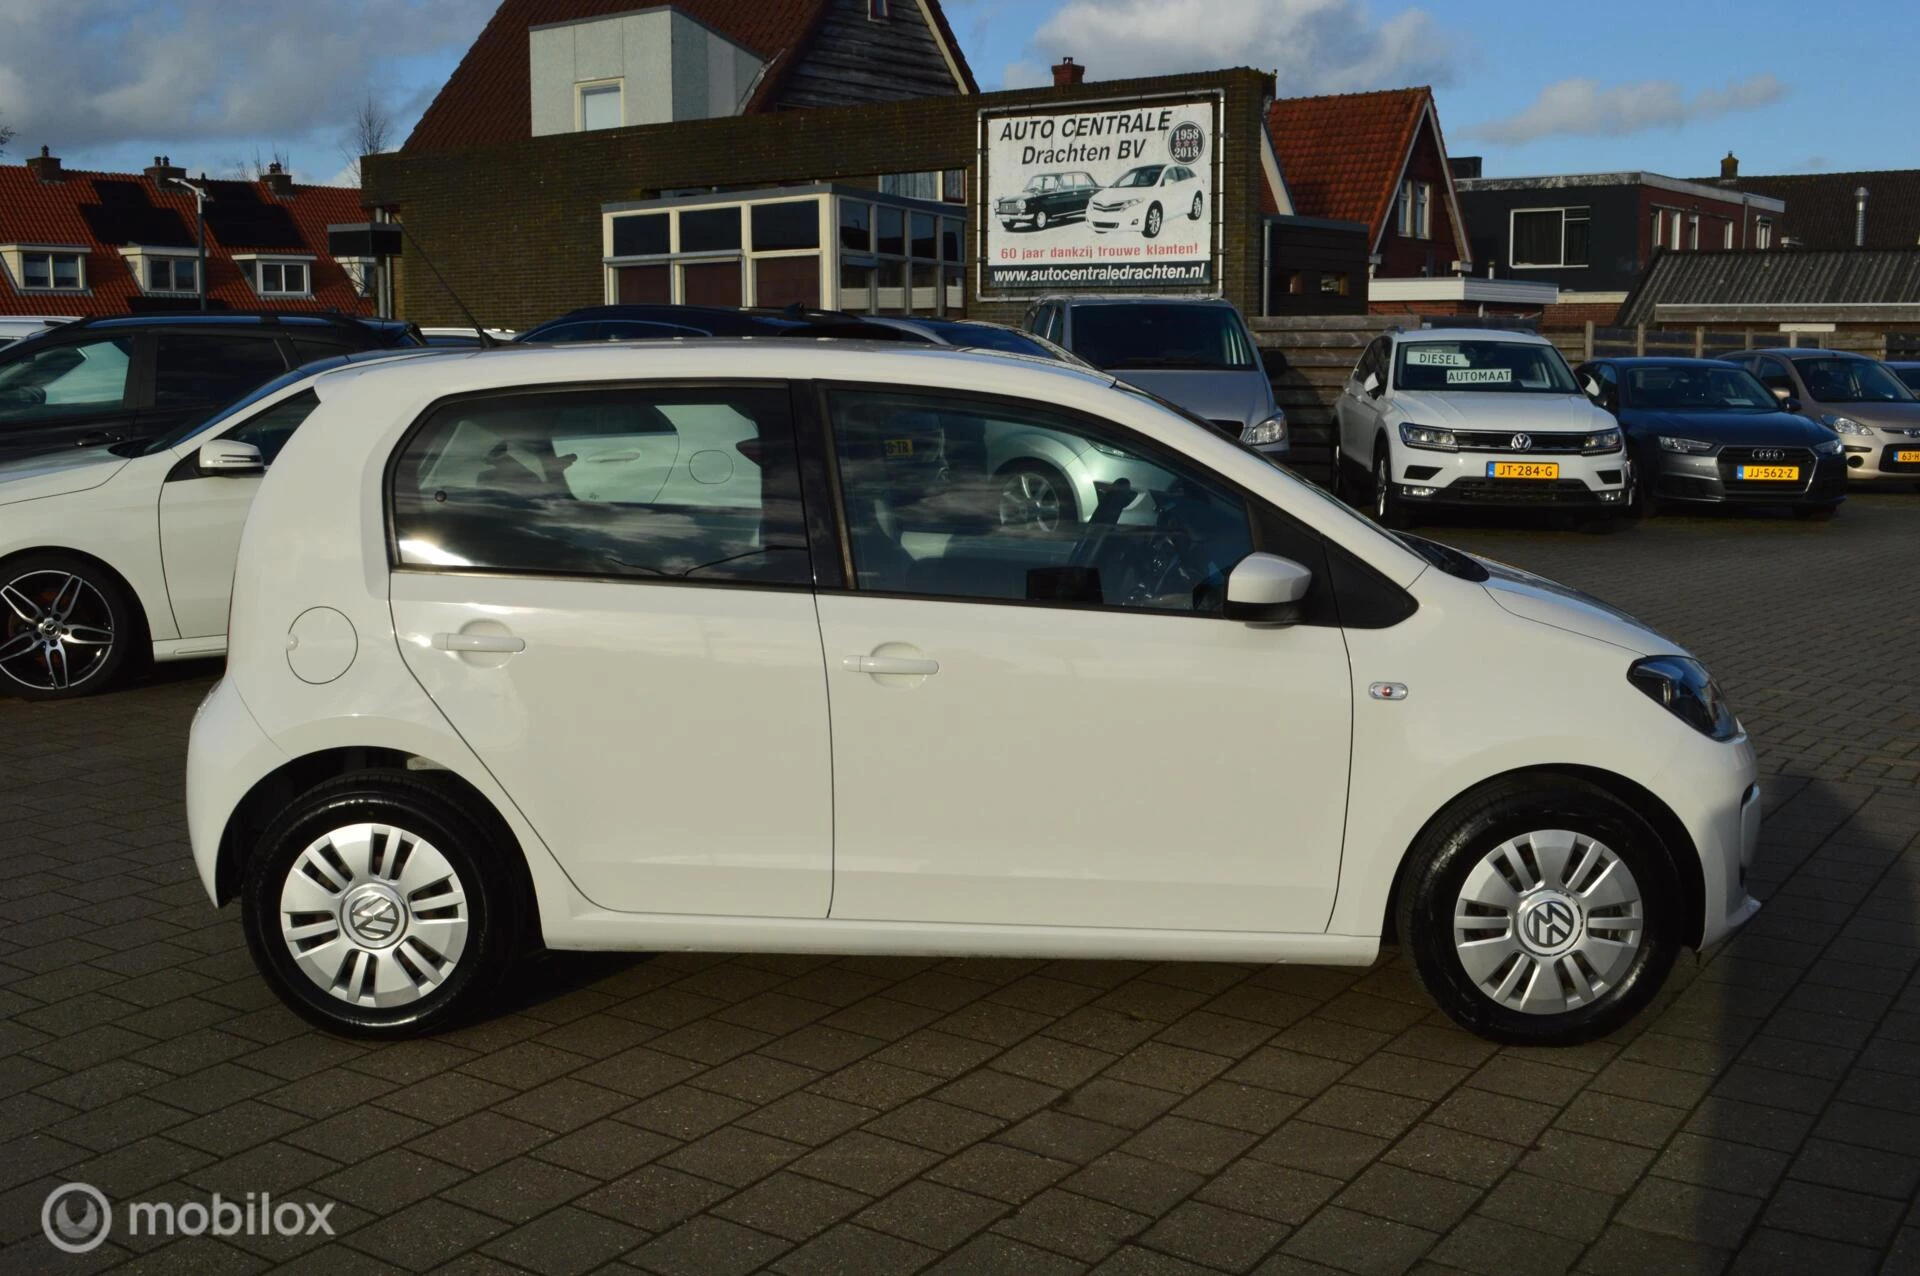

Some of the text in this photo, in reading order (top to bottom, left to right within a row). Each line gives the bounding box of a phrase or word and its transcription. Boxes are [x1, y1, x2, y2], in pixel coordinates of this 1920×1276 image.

[1000, 111, 1172, 141] AUTO CENTRALE
[1175, 128, 1199, 140] 1958
[1022, 139, 1146, 165] Drachten BV
[1174, 146, 1199, 158] 2018
[1001, 243, 1199, 260] 60 jaar dankzij trouwe klanten!
[993, 263, 1205, 282] www.autocentraledrachten.nl
[1419, 353, 1459, 365] DIESEL
[1448, 370, 1511, 383] AUTOMAAT
[1499, 464, 1553, 477] JT-284-G
[1748, 469, 1793, 479] JJ-562-Z
